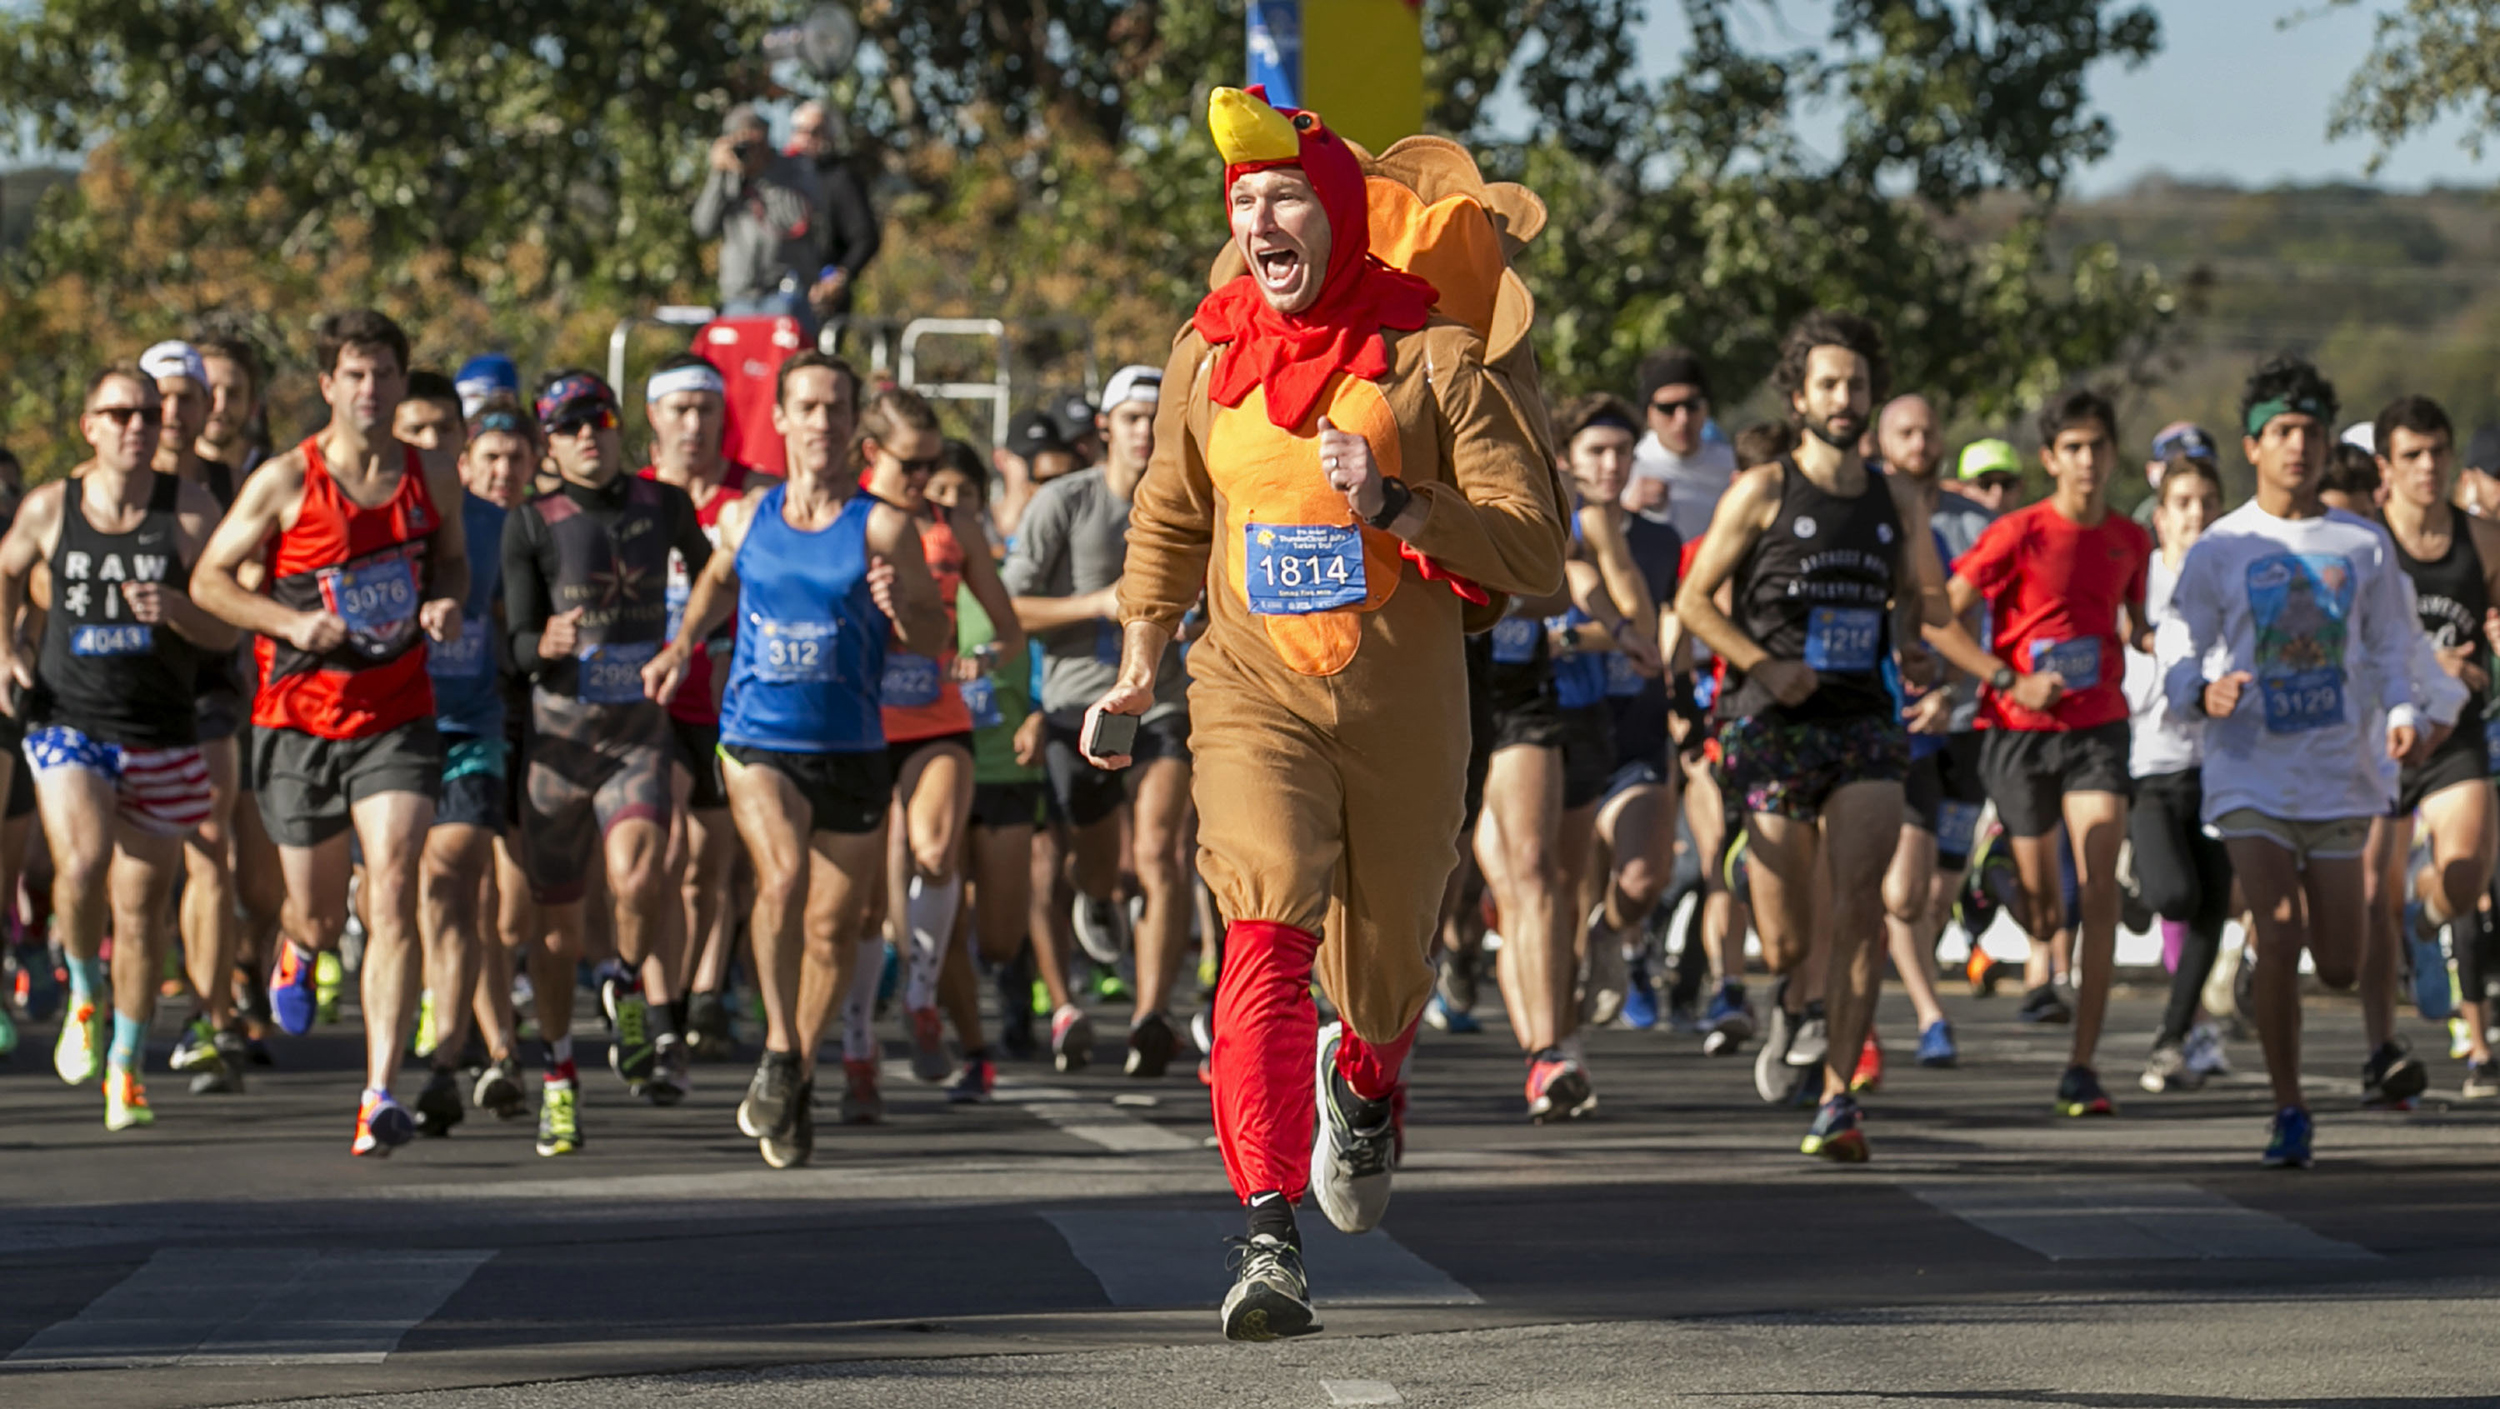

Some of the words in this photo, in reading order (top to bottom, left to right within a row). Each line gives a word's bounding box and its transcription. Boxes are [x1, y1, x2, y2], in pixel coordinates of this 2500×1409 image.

[65, 551, 168, 581] RAW
[1260, 555, 1349, 587] 1814
[344, 578, 409, 613] 3076
[79, 628, 142, 653] 4043
[768, 639, 819, 666] 312
[1820, 627, 1873, 651] 1214
[2271, 686, 2337, 717] 3129
